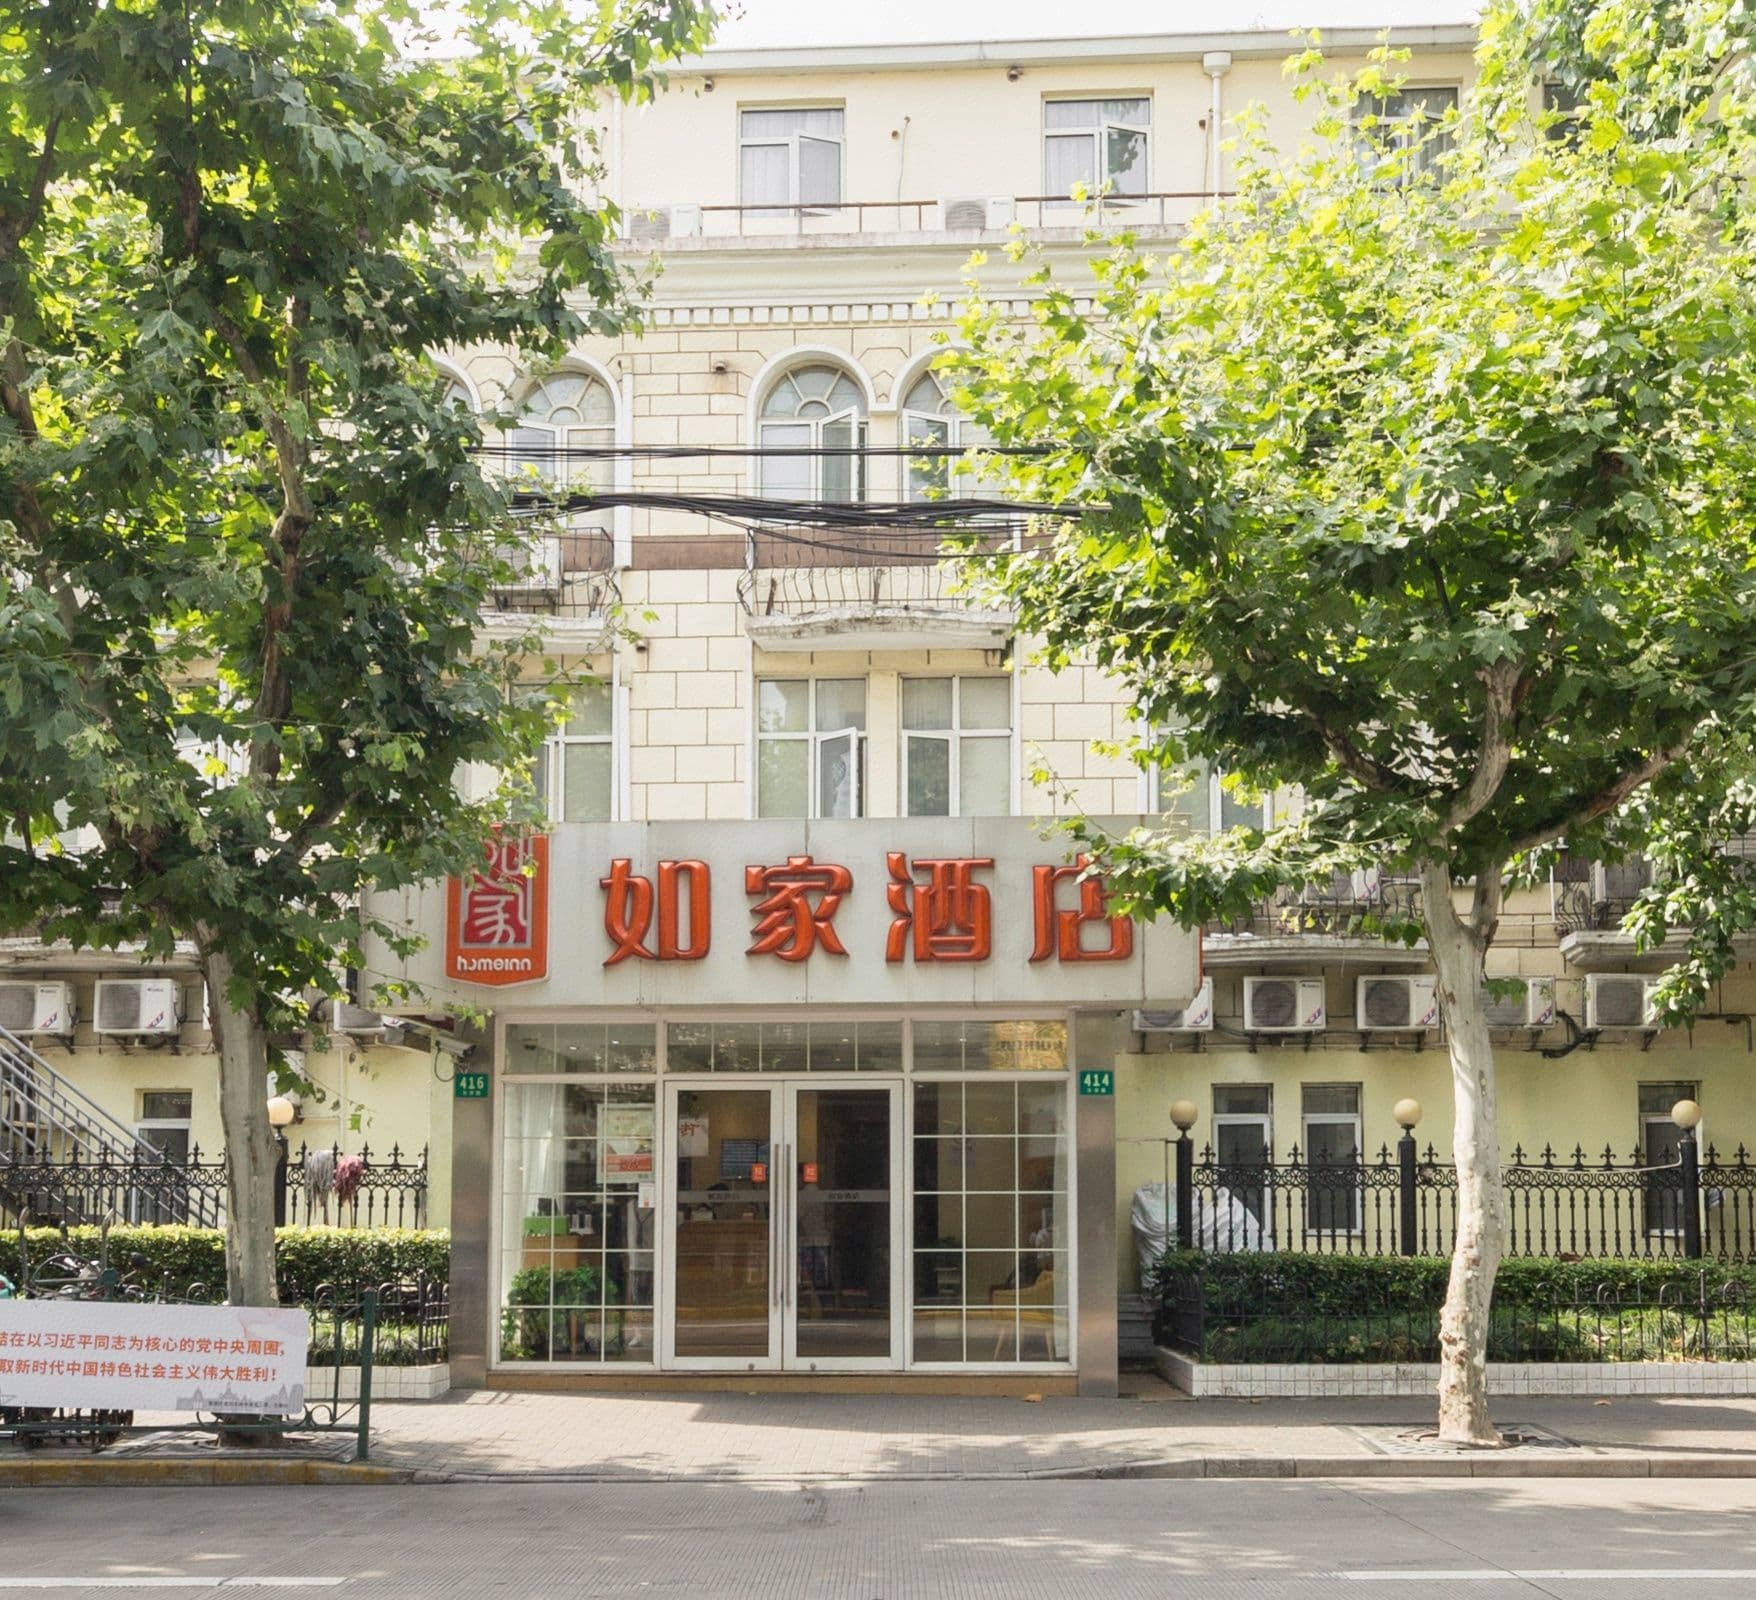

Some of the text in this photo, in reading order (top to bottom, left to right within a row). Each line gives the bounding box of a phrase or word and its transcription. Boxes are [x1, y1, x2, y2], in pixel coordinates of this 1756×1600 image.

[599, 852, 1134, 967] 如家酒店
[456, 955, 532, 972] homeinn
[460, 1076, 484, 1090] 416
[1083, 1073, 1109, 1087] 414
